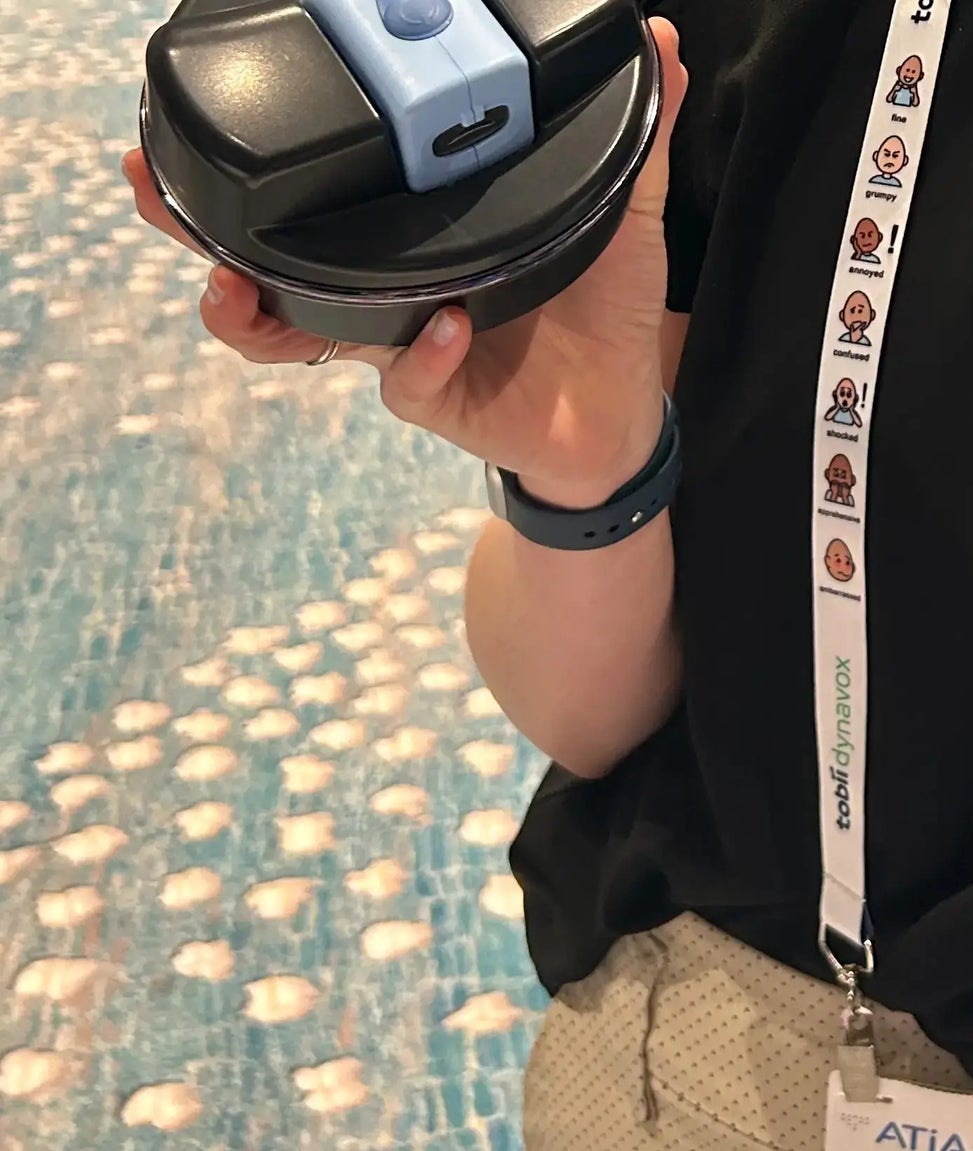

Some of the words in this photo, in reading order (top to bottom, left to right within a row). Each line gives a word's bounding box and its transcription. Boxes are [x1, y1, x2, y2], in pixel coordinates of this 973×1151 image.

[865, 190, 897, 202] grumpy
[848, 266, 884, 278] annoyed
[833, 349, 870, 362] confused
